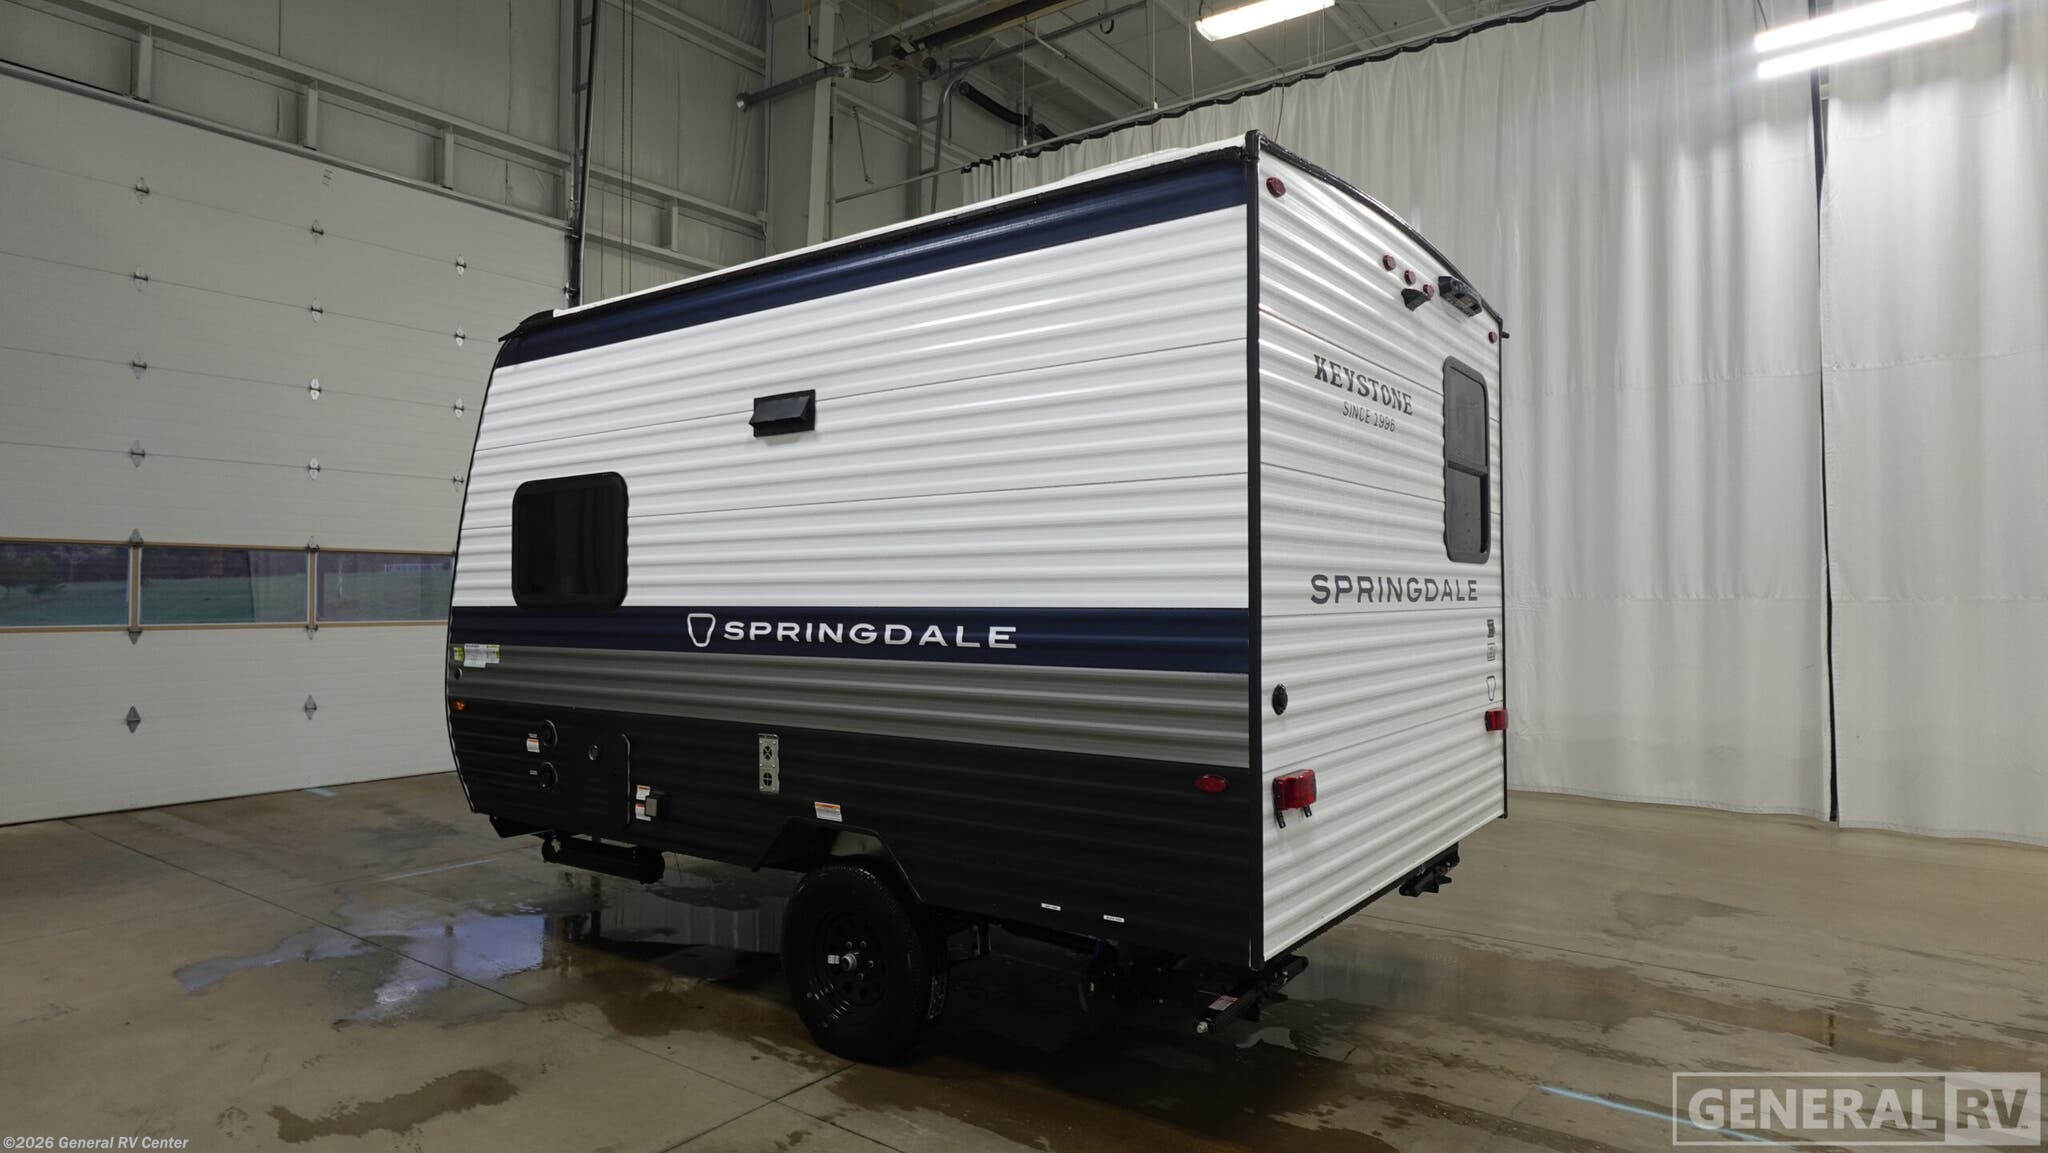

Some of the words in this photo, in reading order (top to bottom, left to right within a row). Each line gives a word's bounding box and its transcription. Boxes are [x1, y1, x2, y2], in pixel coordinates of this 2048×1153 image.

[1313, 354, 1413, 416] KEYSTONE
[1342, 400, 1371, 424] SINCE
[1310, 574, 1478, 604] SPRINGDALE
[723, 620, 1017, 649] SPRINGDALE
